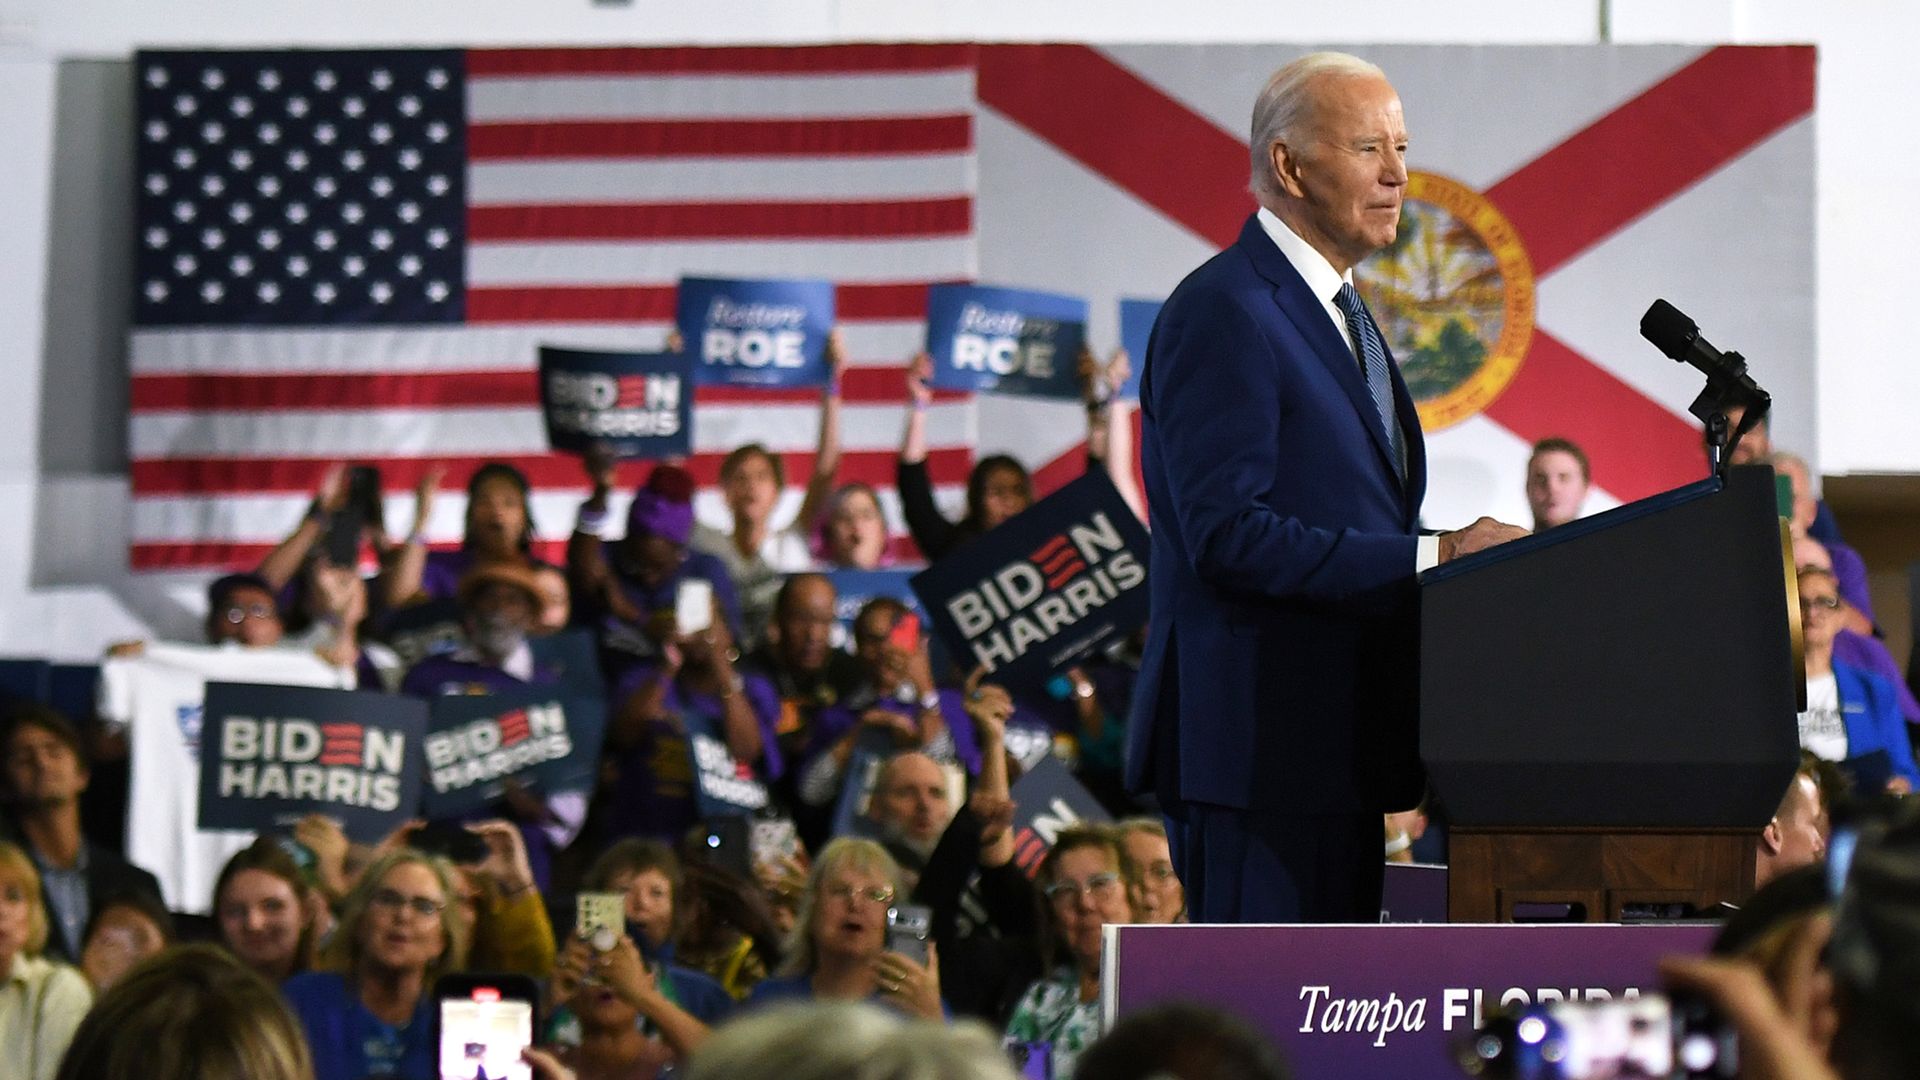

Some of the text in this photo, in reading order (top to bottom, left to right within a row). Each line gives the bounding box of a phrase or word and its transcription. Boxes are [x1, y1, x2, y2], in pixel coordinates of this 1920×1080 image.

[703, 328, 806, 369] ROE
[952, 333, 1056, 379] ROE
[947, 510, 1125, 641] BIDEN
[972, 551, 1147, 673] HARRIS
[222, 716, 406, 776] BIDEN
[424, 702, 566, 770] BIDEN
[432, 734, 572, 794] HARRIS
[218, 762, 401, 812] HARRIS
[1299, 985, 1427, 1047] Tampa
